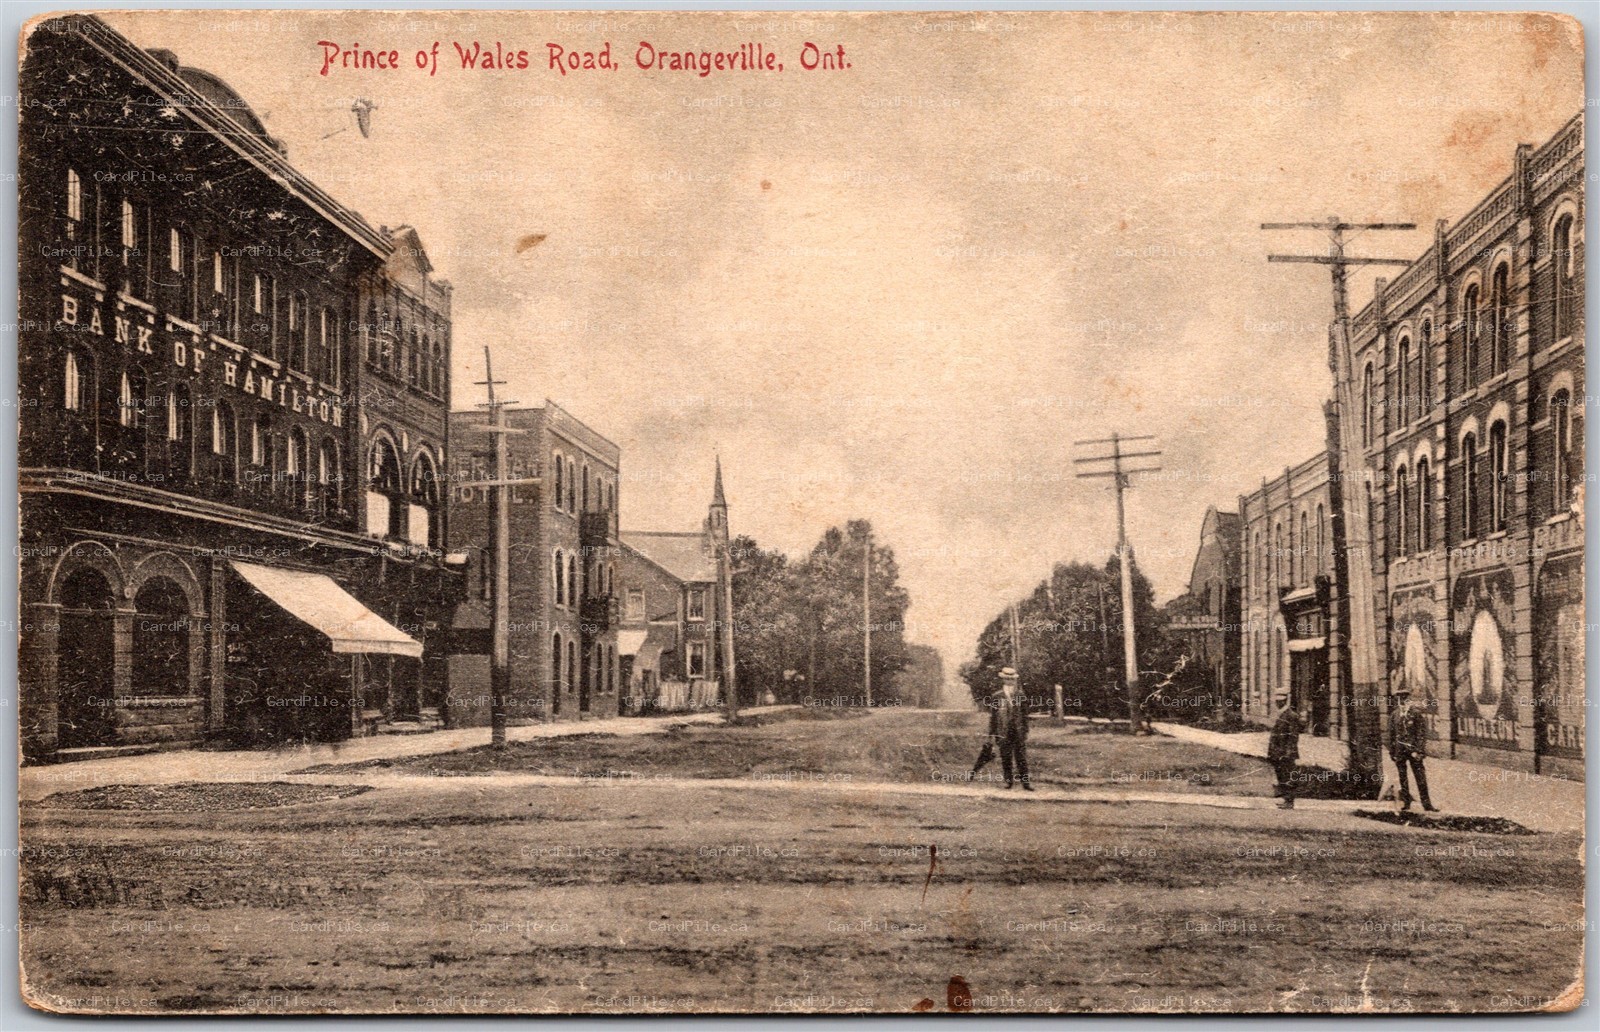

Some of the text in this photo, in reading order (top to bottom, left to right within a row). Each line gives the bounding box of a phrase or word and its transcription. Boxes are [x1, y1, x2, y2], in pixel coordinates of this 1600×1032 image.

[62, 294, 342, 427] BANK OF HAMILTON
